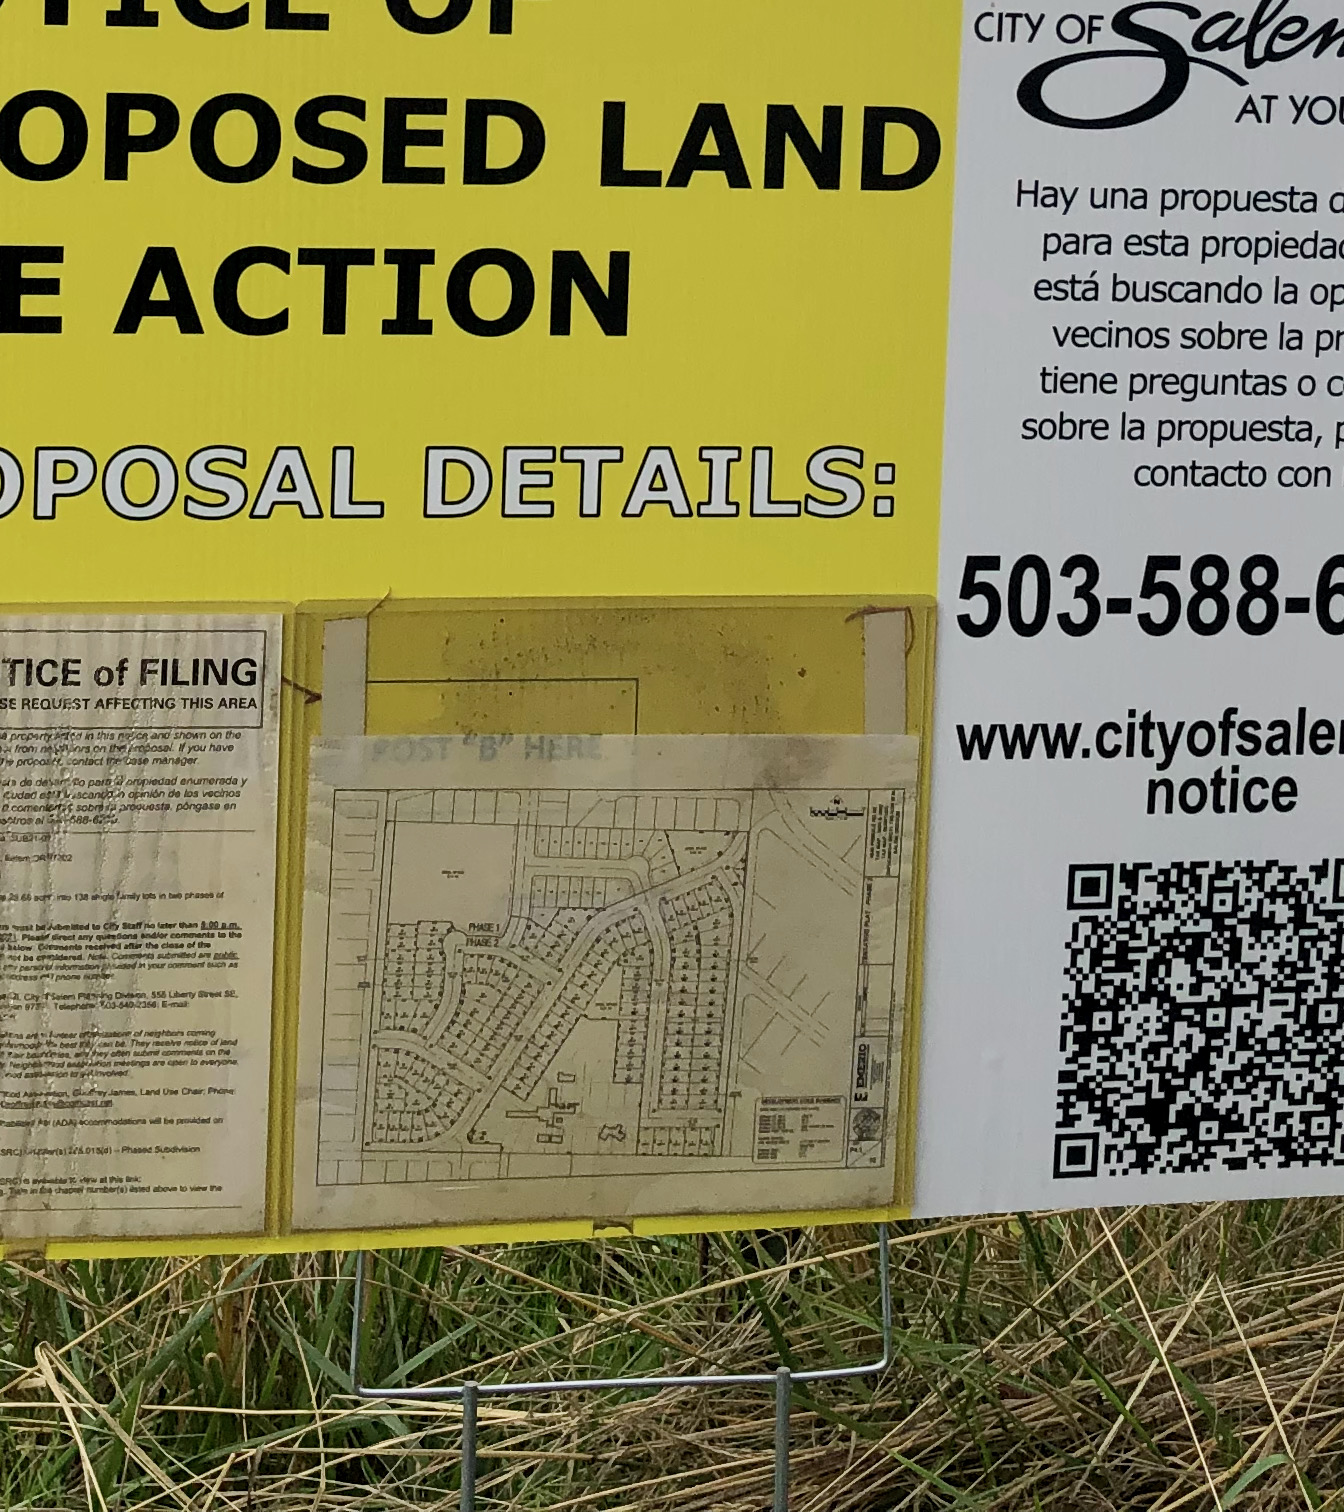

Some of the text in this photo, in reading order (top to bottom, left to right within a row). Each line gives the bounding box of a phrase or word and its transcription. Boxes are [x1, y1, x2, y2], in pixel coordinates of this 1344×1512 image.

[975, 12, 1104, 44] CITY OF
[1235, 95, 1278, 123] AT
[601, 101, 941, 191] LAND
[1017, 180, 1079, 215] Hay
[1090, 188, 1147, 209] una
[1160, 186, 1317, 218] propuesta
[1043, 233, 1111, 261] para
[1124, 230, 1188, 257] esta
[113, 246, 630, 337] ACTION
[1034, 270, 1098, 301] está
[1112, 273, 1262, 304] buscando
[1274, 276, 1298, 304] la
[1053, 321, 1169, 349] vecinos
[1180, 321, 1267, 350] sobre
[1279, 322, 1303, 350] la
[1040, 366, 1117, 394] tiene
[1129, 369, 1287, 402] preguntas
[1298, 375, 1316, 396] o
[1022, 411, 1109, 440] sobre
[1121, 412, 1144, 440] la
[1157, 415, 1322, 448] propuesta,
[423, 445, 895, 518] DETAILS:
[1134, 460, 1266, 487] contacto
[1278, 466, 1331, 487] con
[94, 658, 128, 687] of
[140, 658, 257, 686] FILING
[22, 698, 90, 710] REQUEST
[94, 698, 175, 710] AFFECTING
[181, 697, 213, 709] THIS
[218, 697, 257, 709] AREA
[174, 731, 206, 739] shown
[226, 731, 241, 739] the
[178, 744, 186, 752] If
[188, 745, 206, 754] you
[209, 744, 234, 752] have
[168, 790, 180, 798] de
[184, 789, 199, 798] los
[202, 789, 240, 798] vecinos
[180, 777, 238, 786] enumerada
[241, 779, 248, 787] y
[1147, 765, 1297, 814] notice
[176, 802, 220, 813] póngase
[469, 922, 493, 931] PHASE
